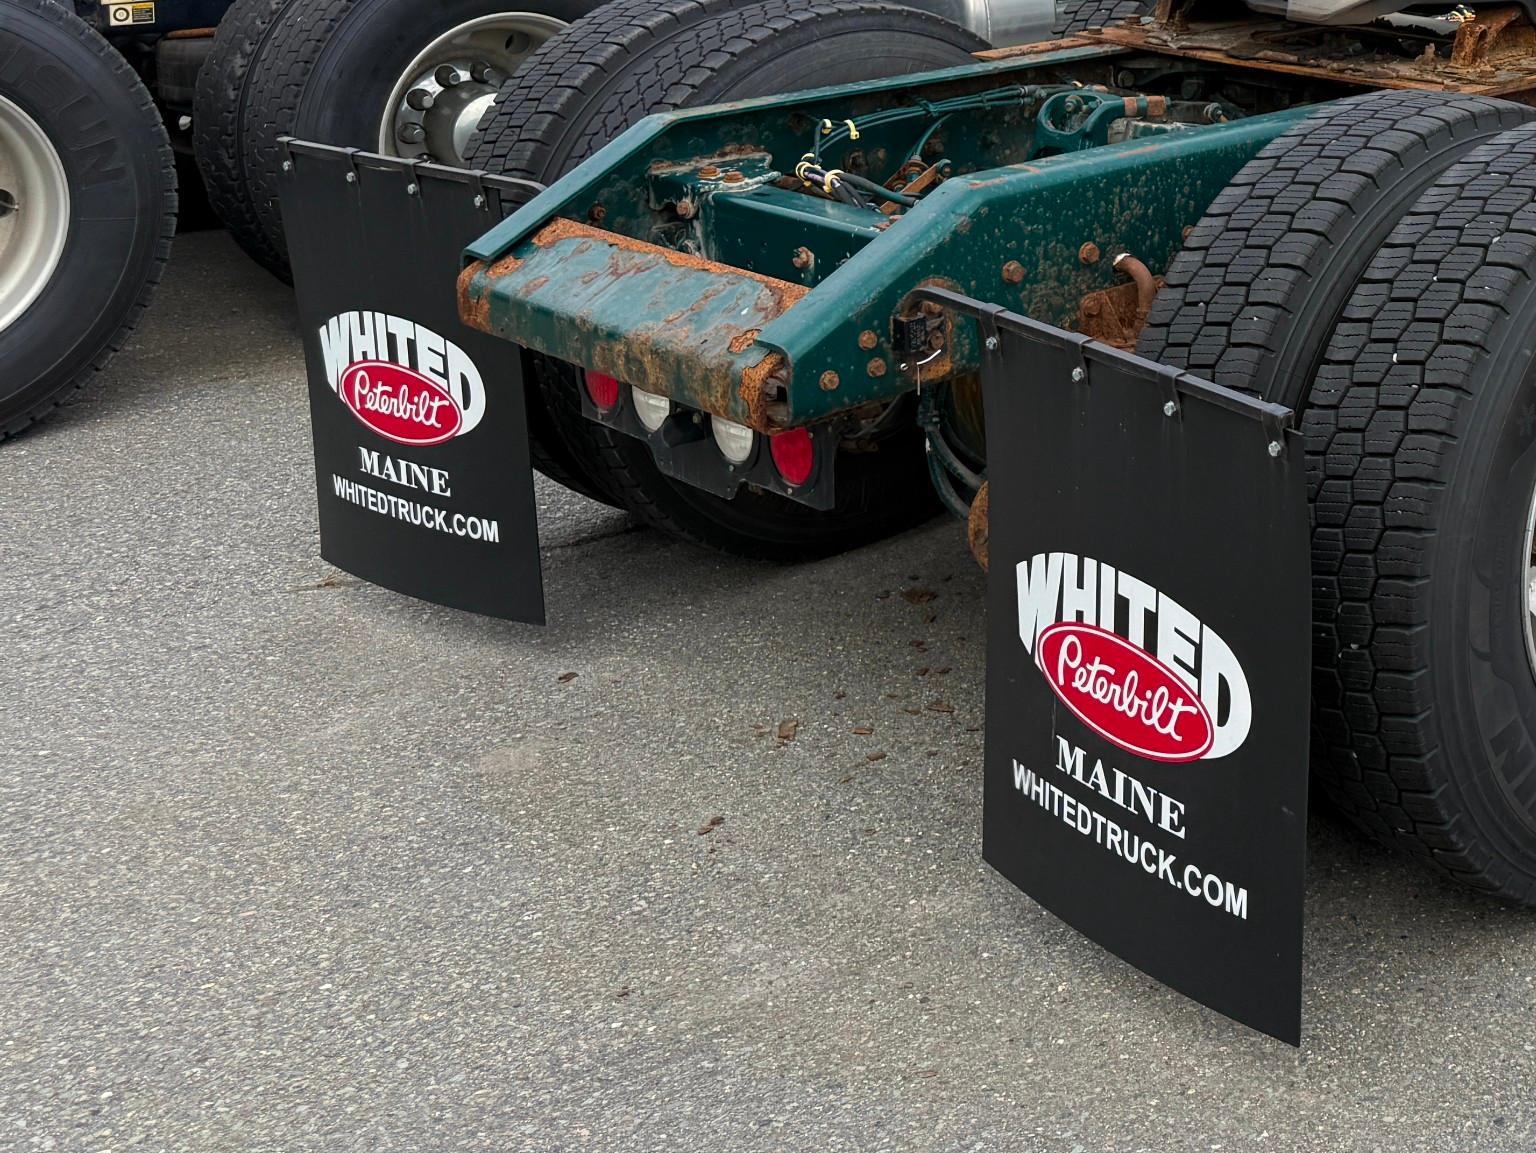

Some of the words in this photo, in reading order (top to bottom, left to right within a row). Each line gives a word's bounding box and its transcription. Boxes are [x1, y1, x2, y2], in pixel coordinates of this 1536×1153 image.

[319, 311, 486, 436] WHITED
[353, 370, 449, 428] Peterbilt
[332, 473, 500, 543] WHITEDTRUCK.COM
[358, 446, 451, 497] MAINE
[1016, 552, 1252, 759] WHITED
[1057, 634, 1198, 741] Peterbilt
[1012, 758, 1249, 920] WHITEDTRUCK.COM
[1055, 734, 1186, 840] MAINE
